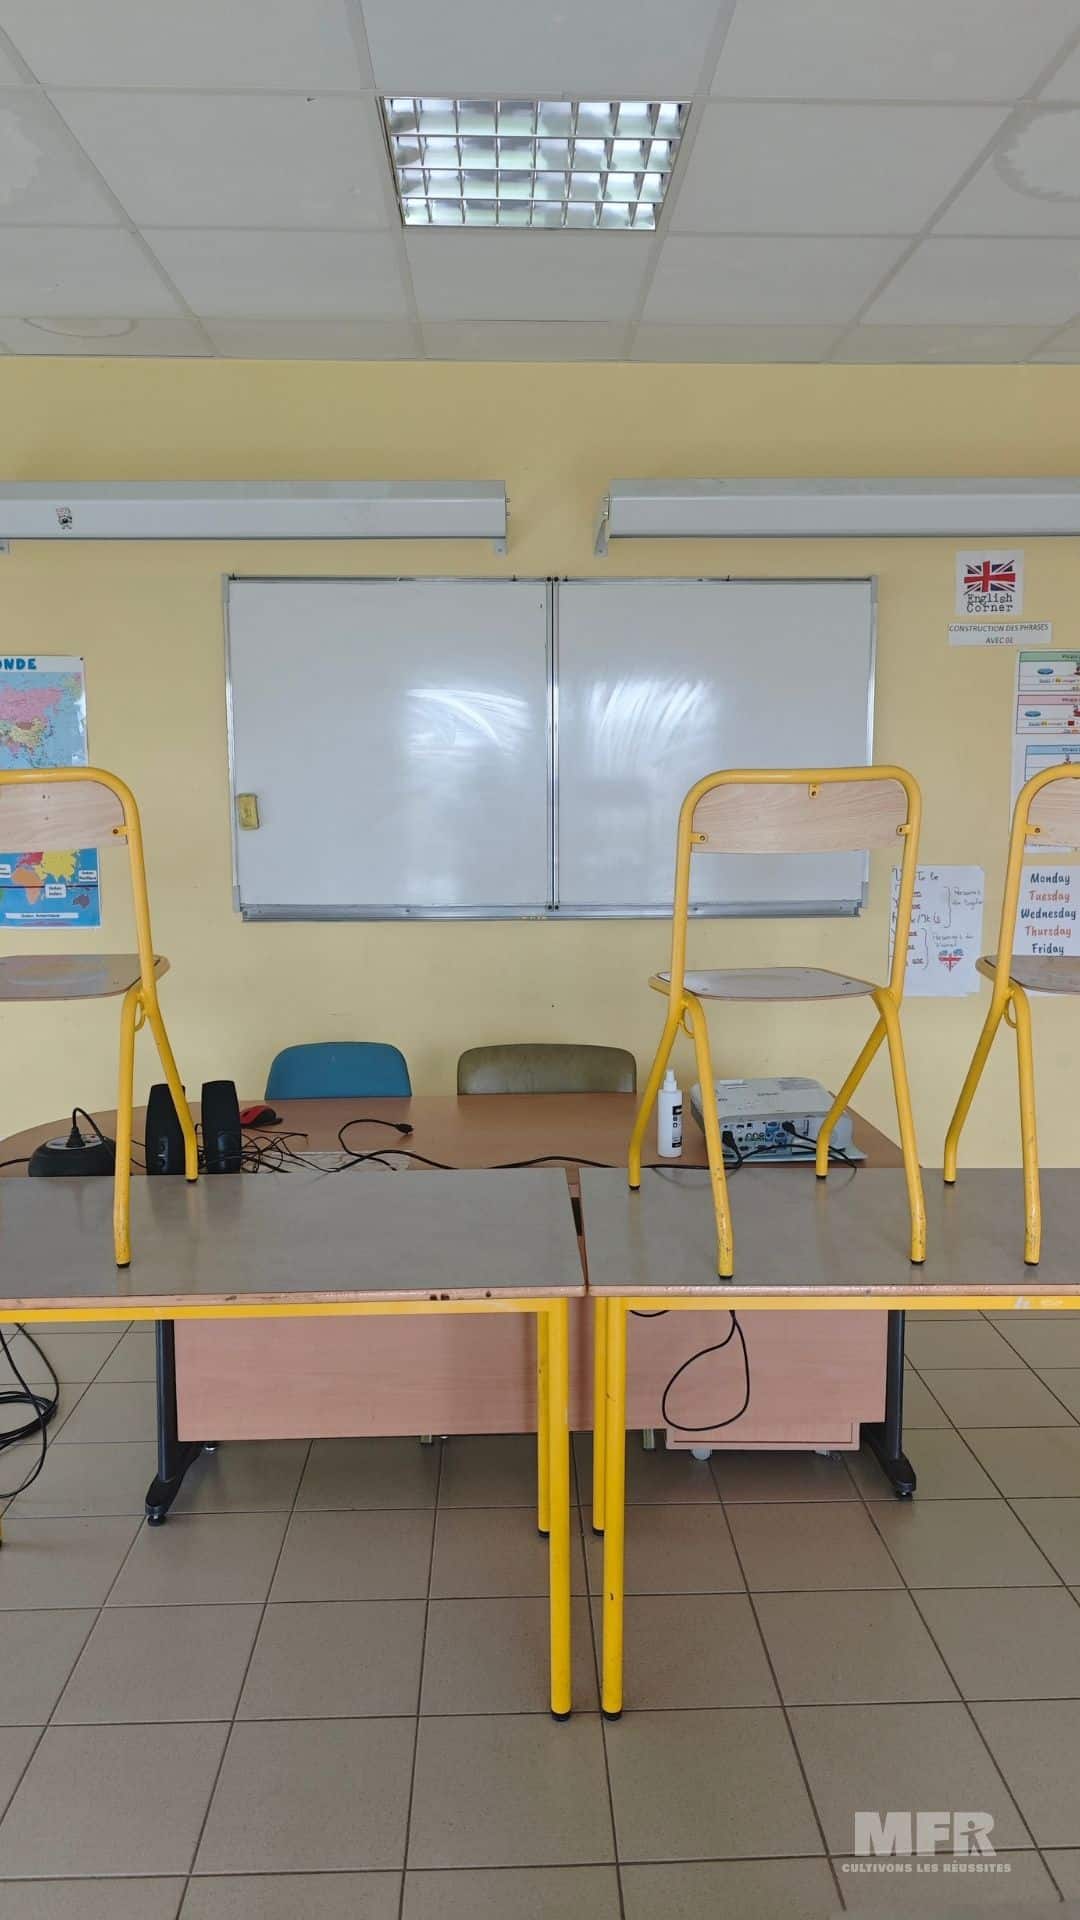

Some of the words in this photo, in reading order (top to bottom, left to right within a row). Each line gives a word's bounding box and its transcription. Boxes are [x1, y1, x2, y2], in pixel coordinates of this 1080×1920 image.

[968, 593, 1013, 605] English
[966, 603, 1013, 613] Corner
[949, 624, 1004, 633] CONSTRUCTION
[1020, 623, 1049, 632] PHRASES
[0, 658, 36, 670] NDE
[1030, 872, 1070, 886] Monday
[1029, 890, 1071, 903] Tuesday
[1021, 907, 1076, 920] Wednesday
[1025, 924, 1072, 938] Thursday
[1032, 942, 1064, 955] Friday
